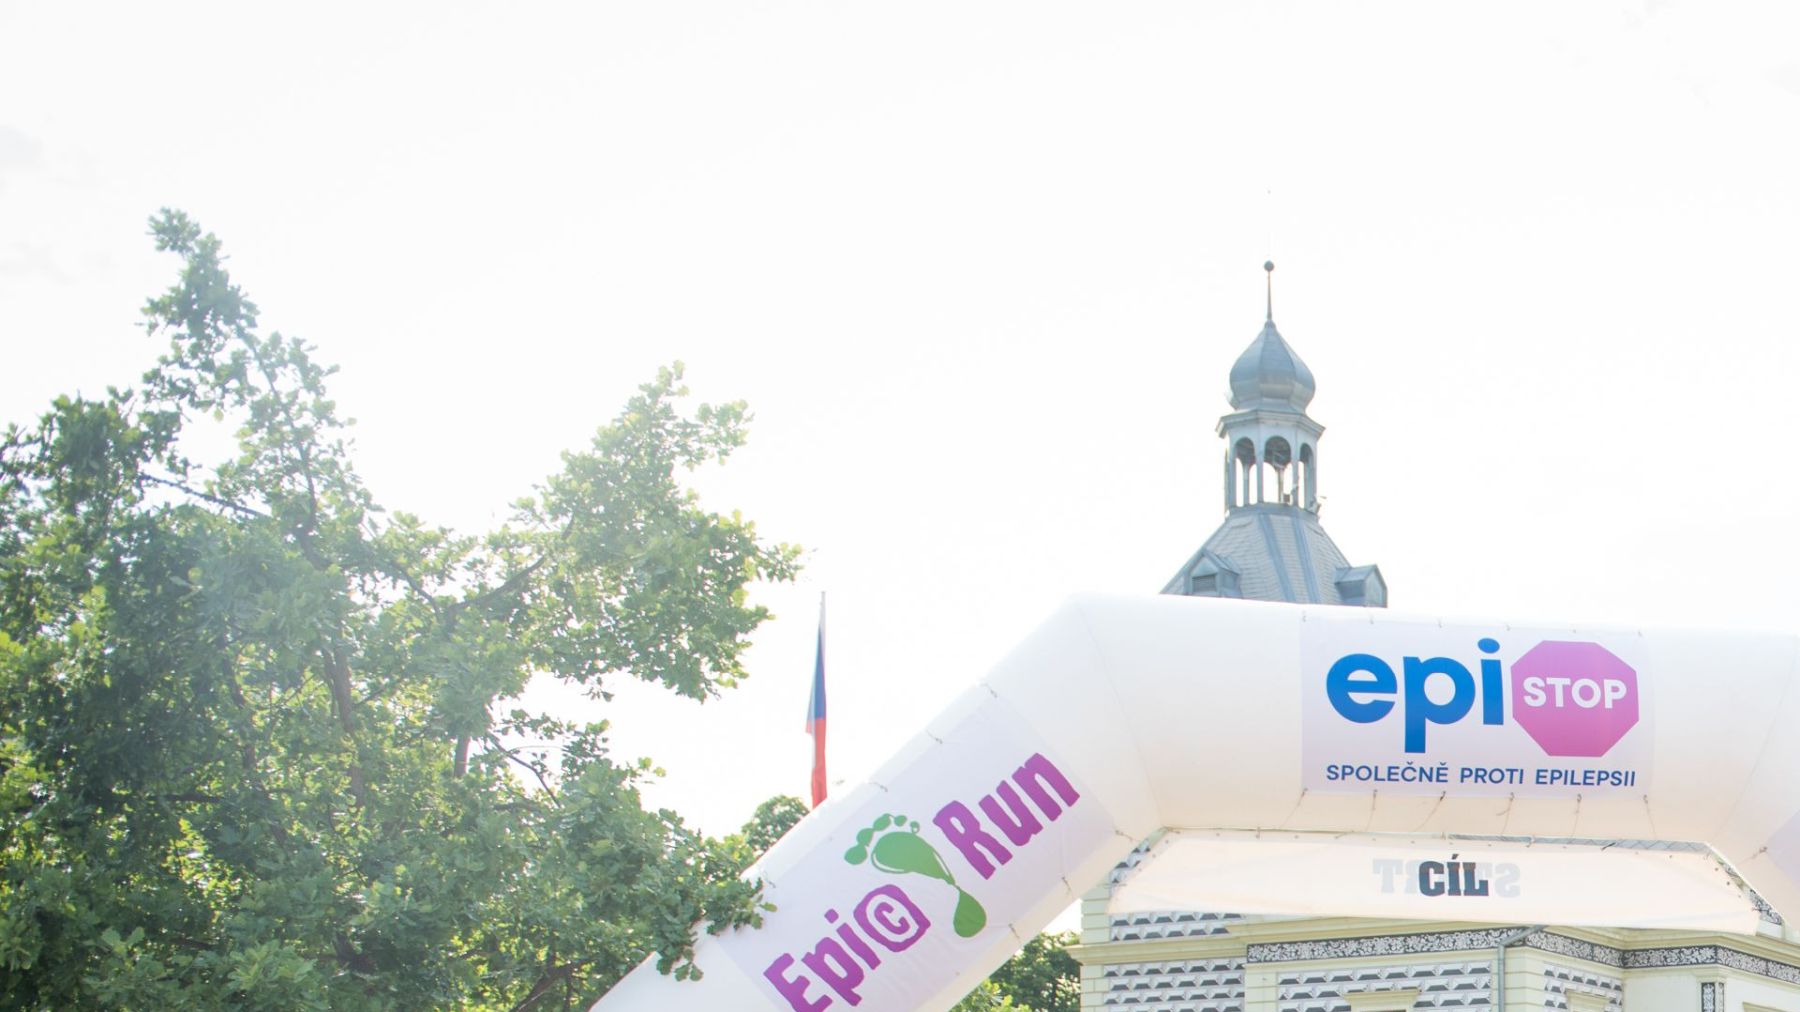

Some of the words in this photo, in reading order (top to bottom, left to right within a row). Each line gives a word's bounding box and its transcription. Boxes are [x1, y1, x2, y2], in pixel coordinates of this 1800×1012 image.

[1326, 638, 1504, 753] epi
[1523, 677, 1627, 709] STOP
[1326, 761, 1449, 783] SPOLEČNĚ
[1460, 767, 1524, 785] PROTI
[1535, 769, 1636, 787] EPILEPSII
[932, 753, 1080, 880] Run
[1419, 854, 1489, 897] CÍL
